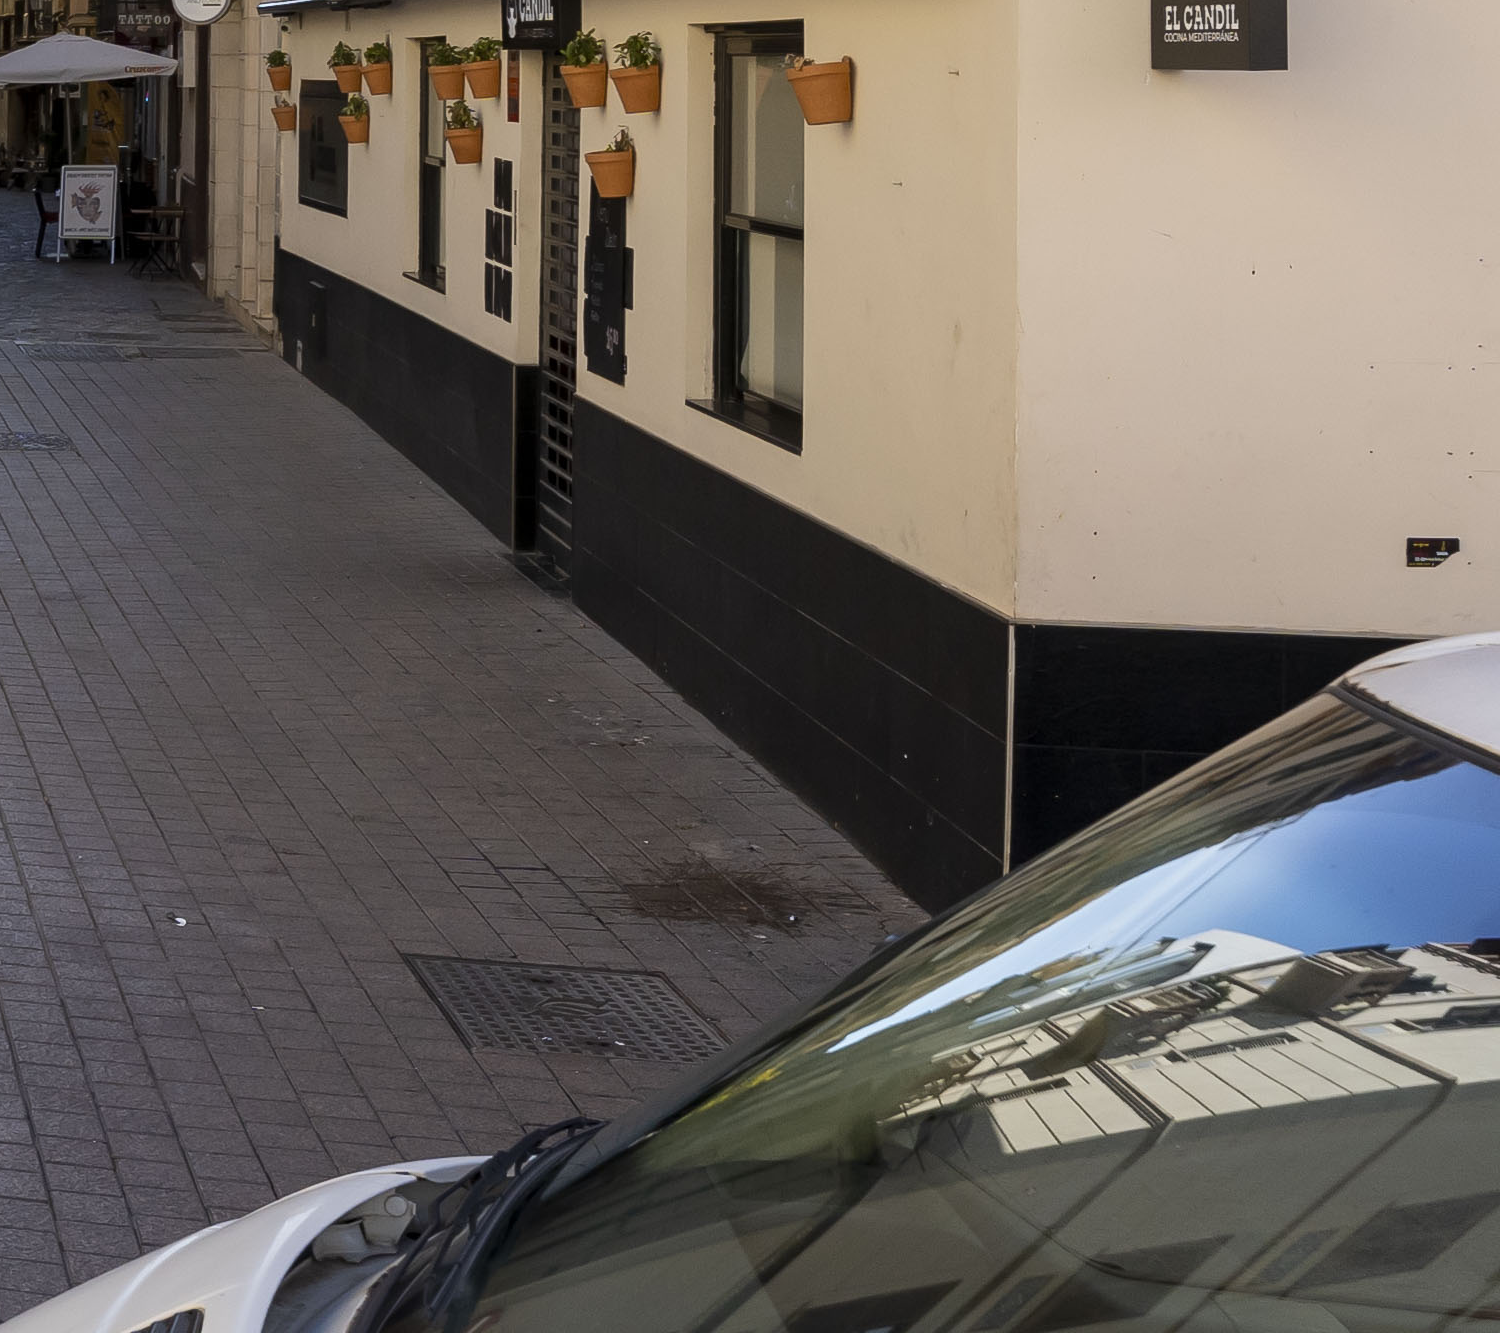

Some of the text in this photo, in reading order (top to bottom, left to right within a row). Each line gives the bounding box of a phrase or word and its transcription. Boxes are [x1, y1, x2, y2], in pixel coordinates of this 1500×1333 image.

[118, 14, 171, 25] TATTOO
[1165, 4, 1240, 31] EL CANDIL
[1164, 30, 1240, 43] COCINA MEDITERRÁNEA
